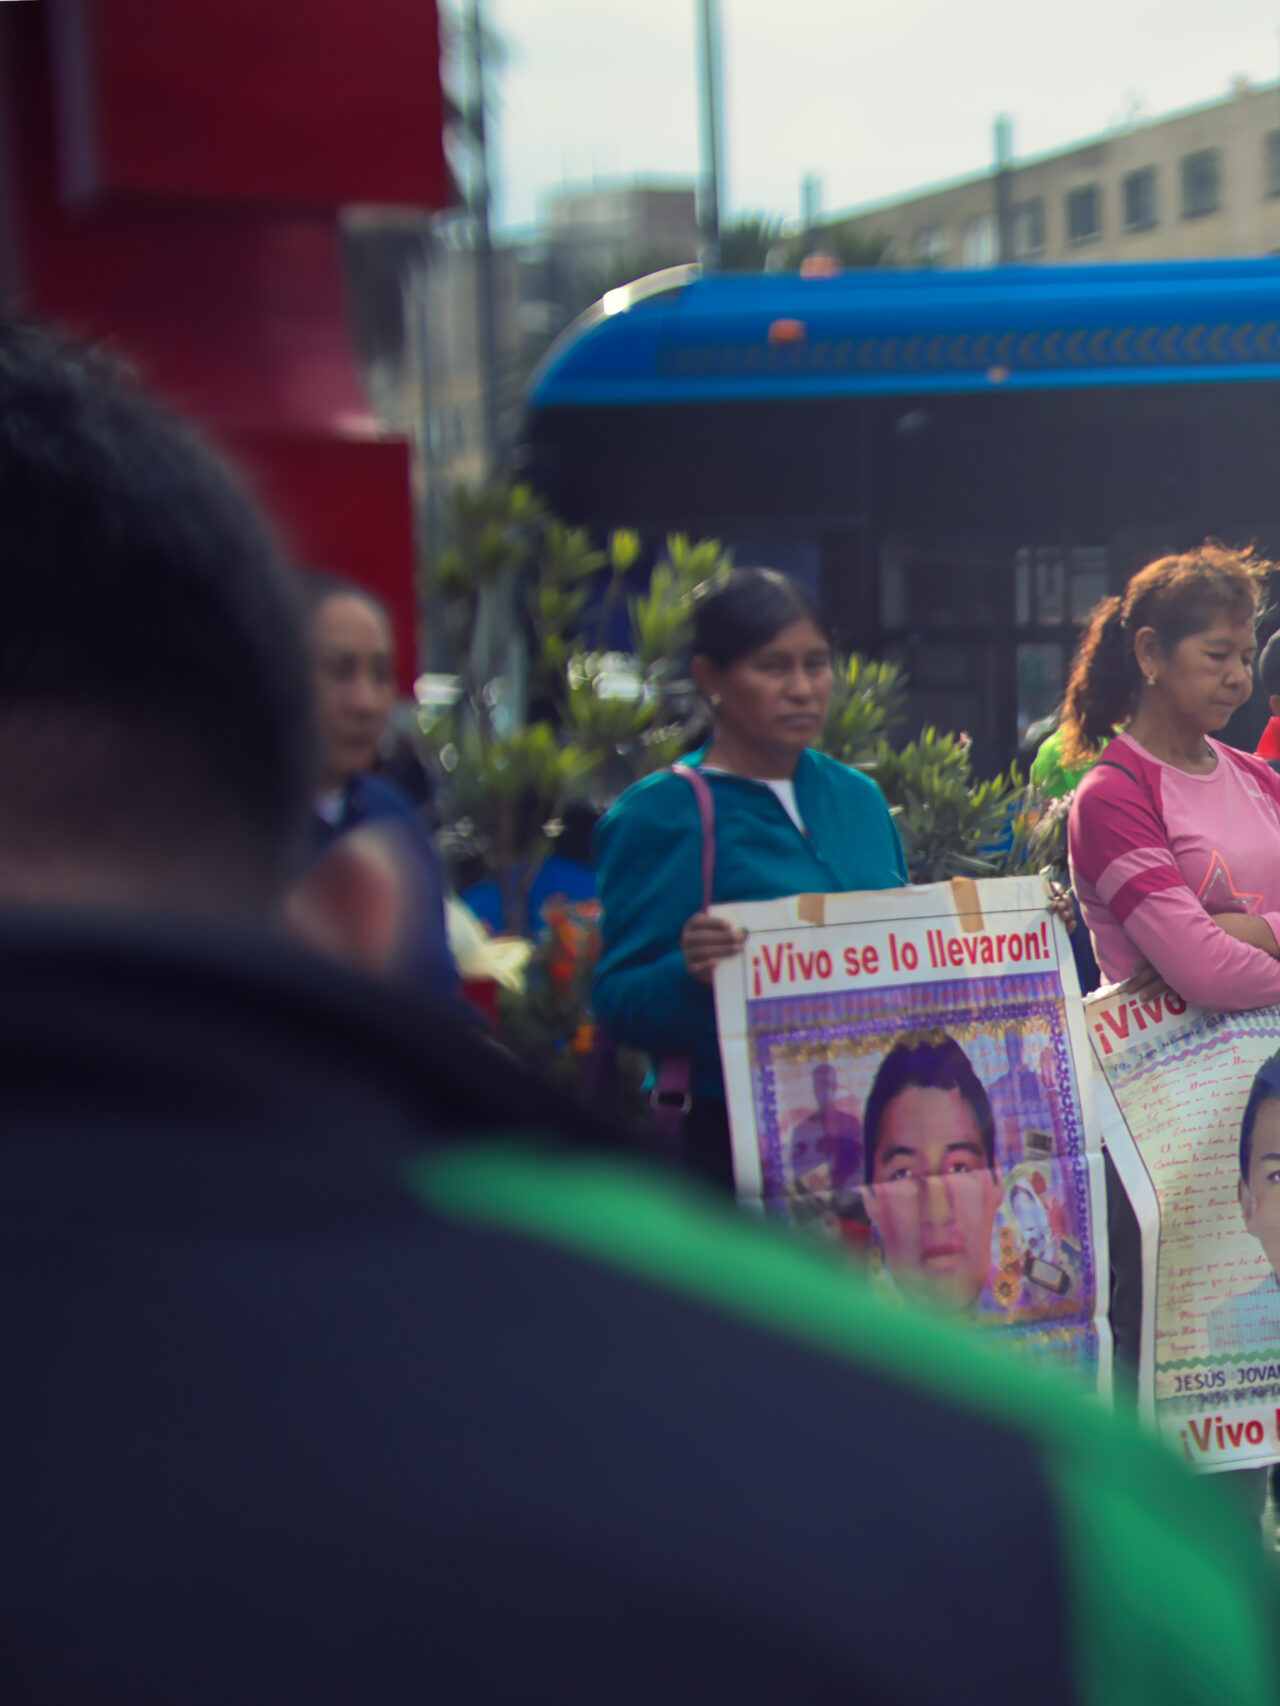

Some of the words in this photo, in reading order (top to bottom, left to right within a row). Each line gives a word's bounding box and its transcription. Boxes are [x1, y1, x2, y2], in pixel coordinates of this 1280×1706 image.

[753, 941, 833, 997] ¡Vivo
[843, 944, 880, 978] se
[888, 932, 920, 972] lo
[926, 921, 1051, 969] llevaron!
[1094, 990, 1188, 1055] ¡Vivo
[1174, 1368, 1226, 1393] JESÚS
[1179, 1416, 1264, 1462] ¡Vivo
